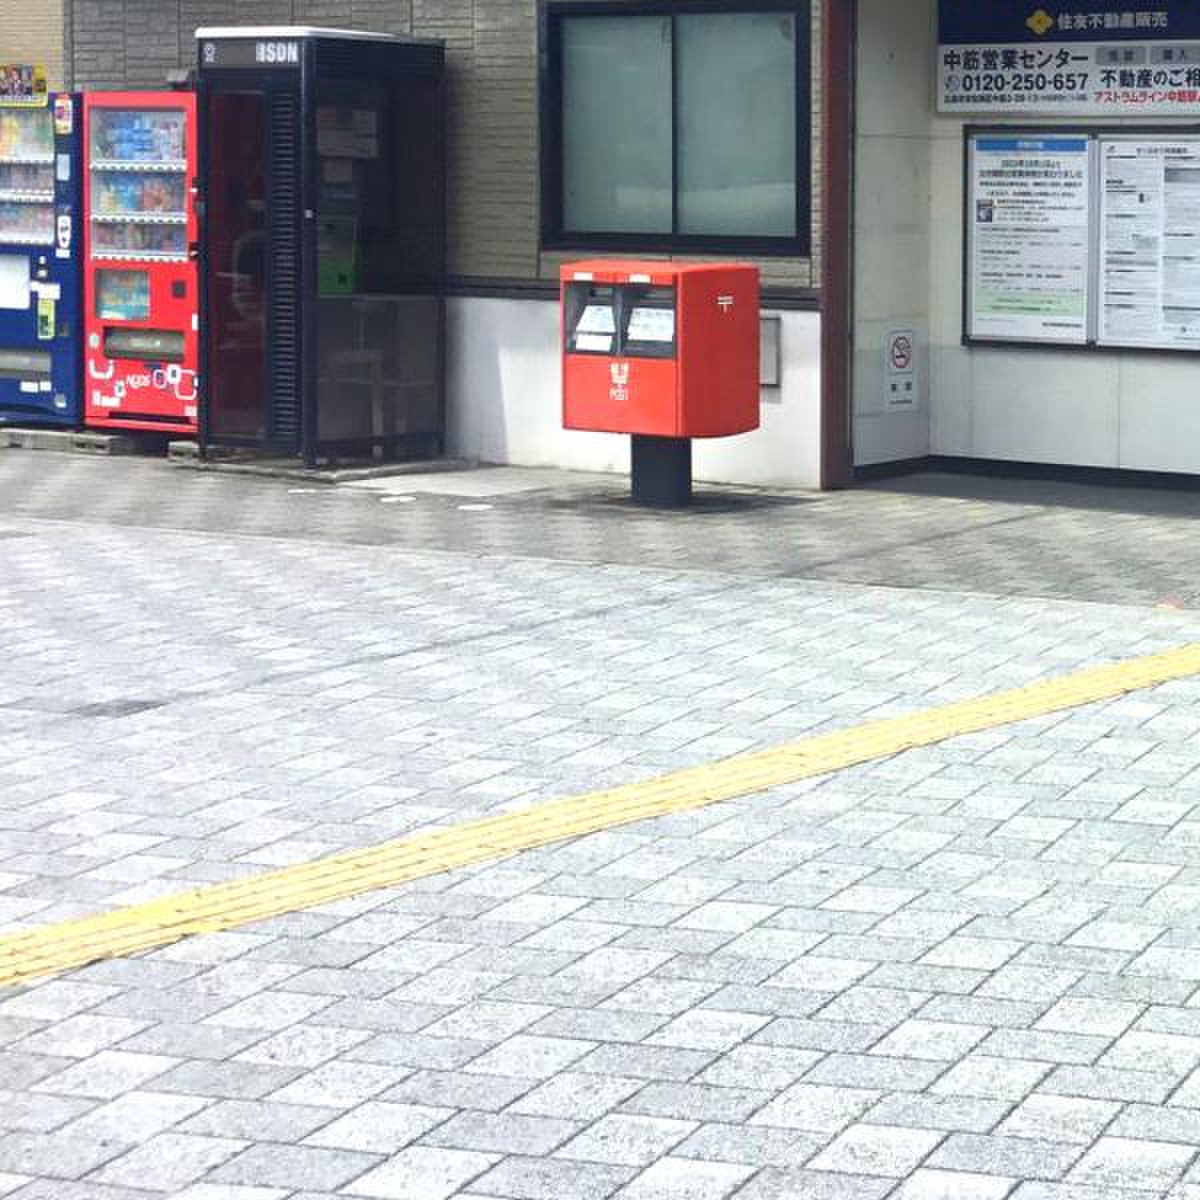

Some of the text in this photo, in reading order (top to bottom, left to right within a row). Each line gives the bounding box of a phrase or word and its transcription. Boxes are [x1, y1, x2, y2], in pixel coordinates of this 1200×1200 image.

[1057, 11, 1168, 29] 住友不動産販売
[256, 42, 299, 62] ISDN
[944, 49, 1089, 71] 中筋営業センター
